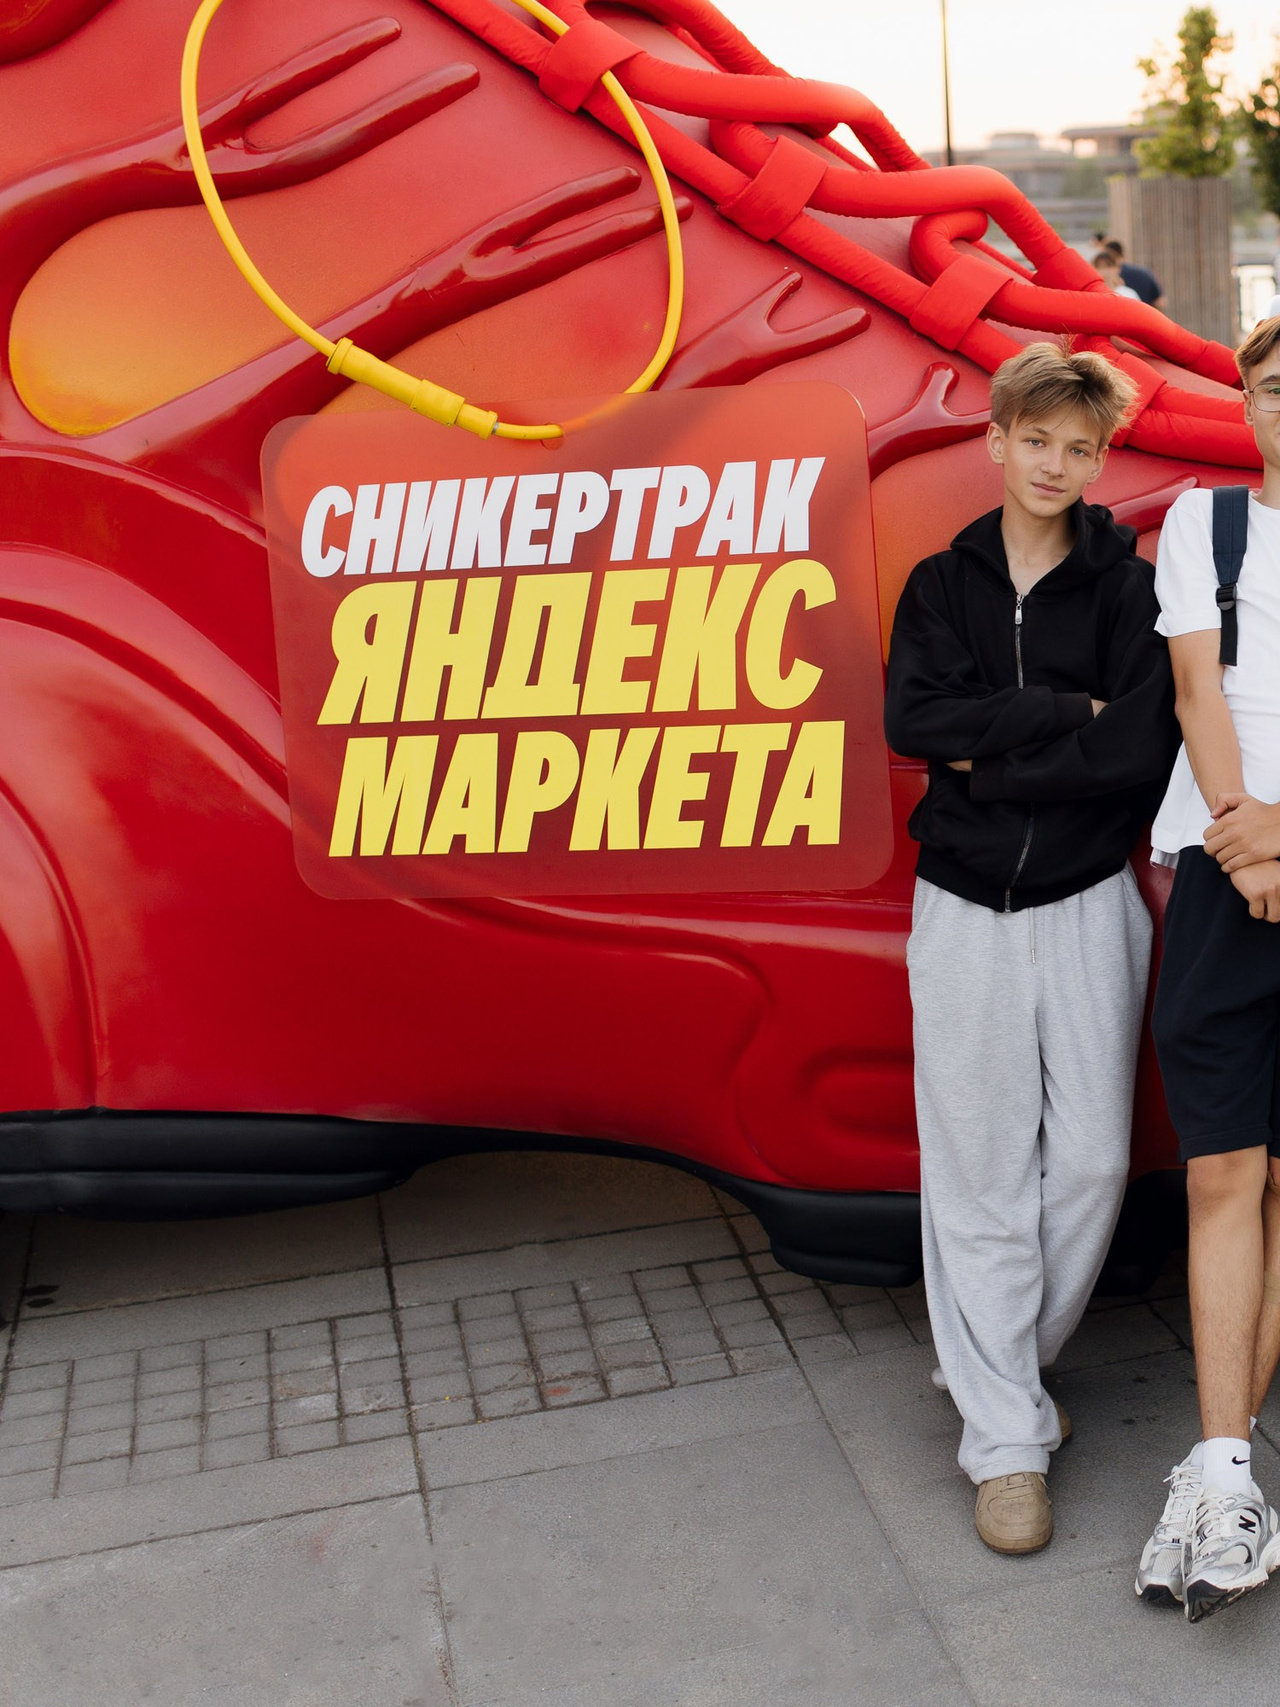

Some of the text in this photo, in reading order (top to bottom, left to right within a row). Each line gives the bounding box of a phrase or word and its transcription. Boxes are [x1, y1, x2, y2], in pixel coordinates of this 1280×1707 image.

[301, 457, 825, 577] СНИКЕРТРАК
[317, 559, 836, 725] ЯНДЕКС
[328, 721, 845, 857] МАРКЕТА
[1238, 1514, 1257, 1534] N
